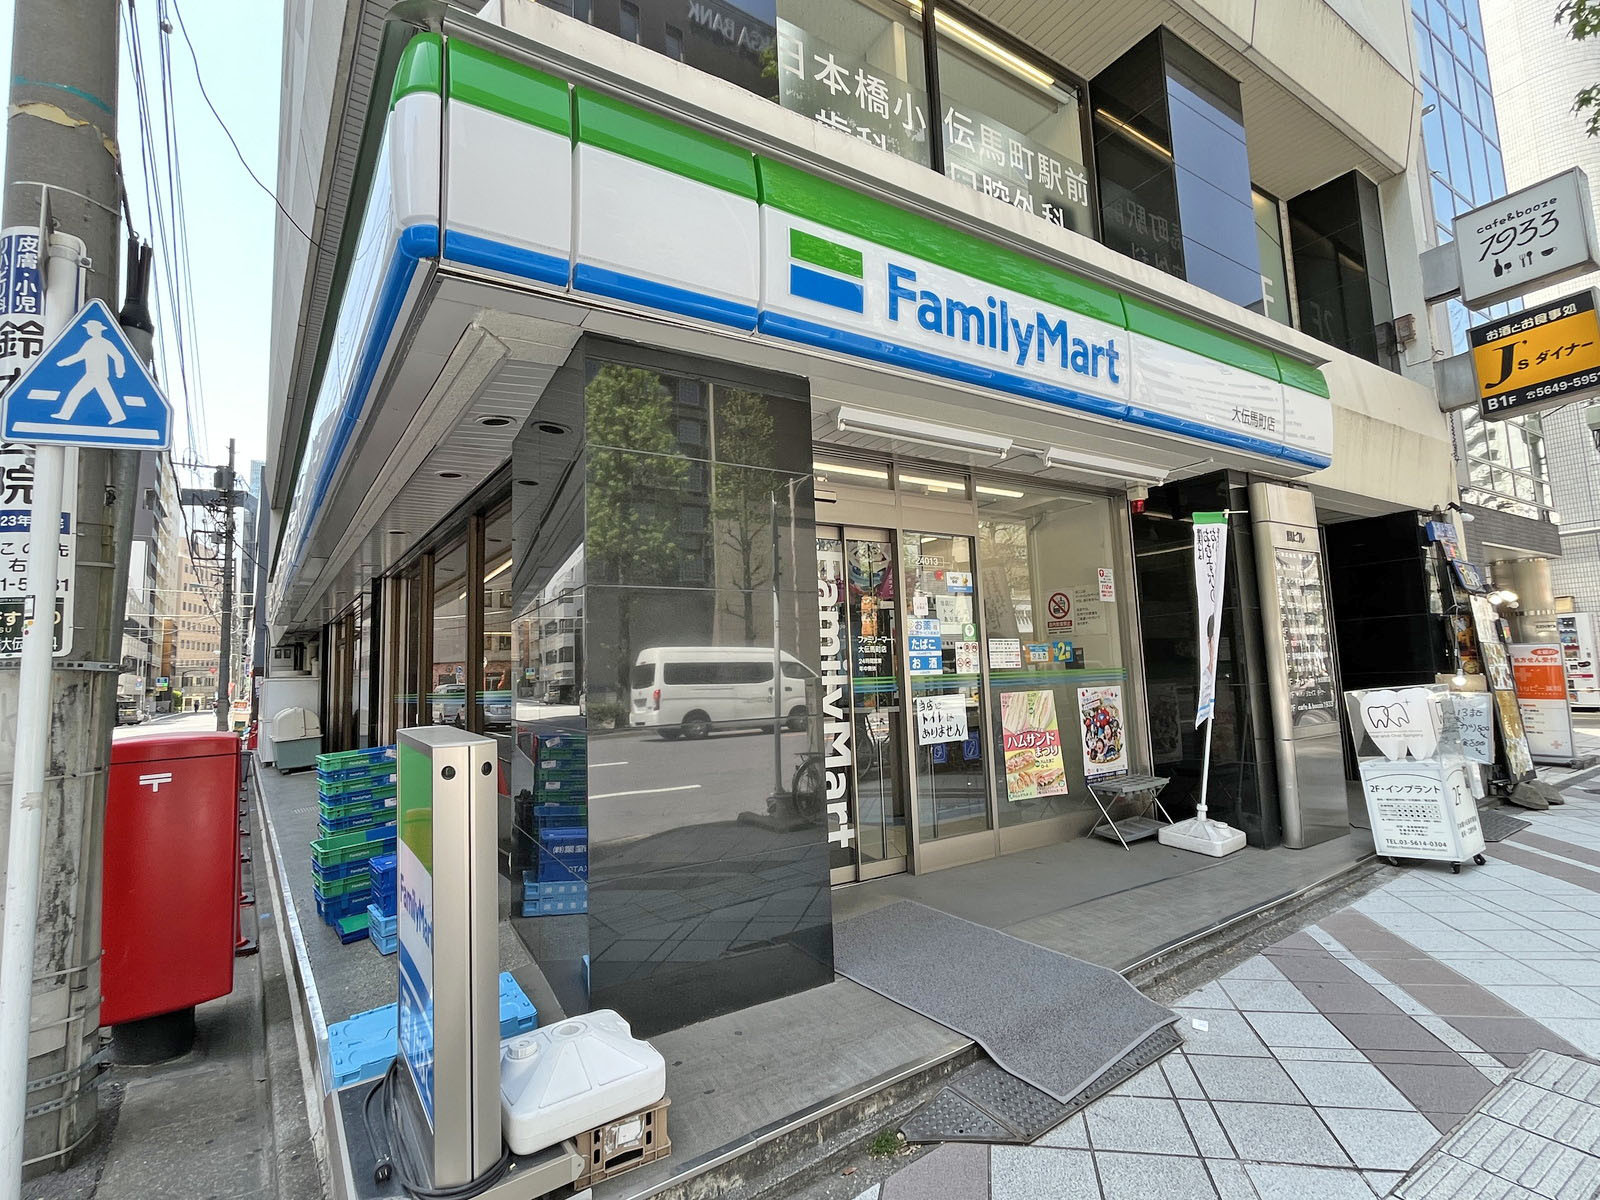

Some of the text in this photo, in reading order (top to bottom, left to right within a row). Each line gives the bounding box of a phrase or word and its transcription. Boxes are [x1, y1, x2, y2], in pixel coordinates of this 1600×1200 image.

[1476, 197, 1557, 234] cafe&booze
[1478, 209, 1560, 263] 1933
[887, 261, 1120, 384] FamilyMart
[1485, 303, 1578, 341] お酒とお食事処
[1536, 341, 1594, 366] ダイナー
[1487, 371, 1600, 411] B1F 5649-595
[1231, 406, 1276, 433] 大伝馬町店
[911, 639, 937, 650] たばこ
[921, 723, 966, 739] ありません
[1007, 731, 1055, 750] ハムサンド
[1034, 745, 1059, 759] まつり
